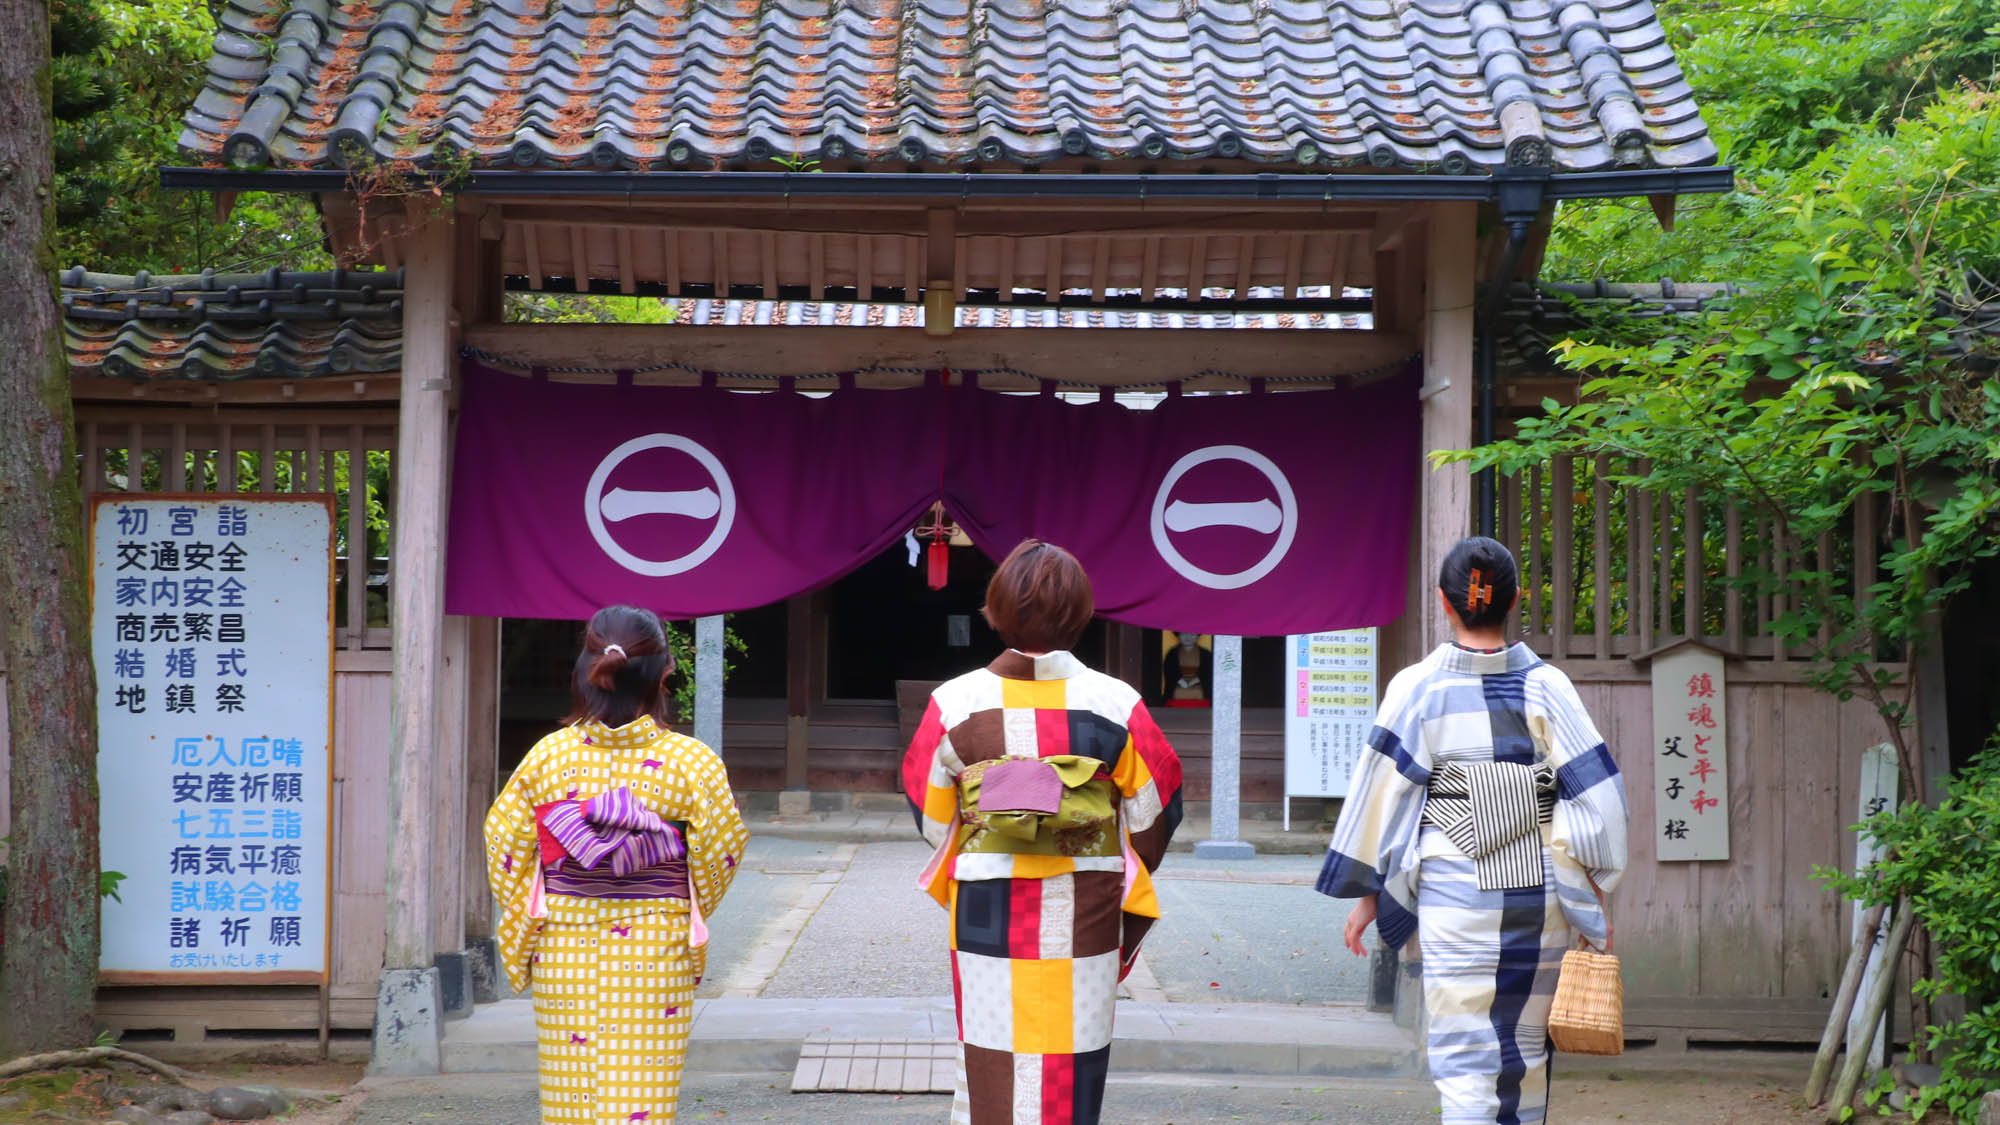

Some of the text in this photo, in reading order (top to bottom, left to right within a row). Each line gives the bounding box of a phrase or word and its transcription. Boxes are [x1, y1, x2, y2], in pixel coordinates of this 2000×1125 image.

[117, 505, 248, 536] 初宮詣
[116, 540, 248, 572] 交通安全
[115, 576, 247, 608] 家内安全
[115, 612, 246, 643] 商売繁昌
[114, 647, 247, 678] 結婚式
[115, 683, 246, 714] 地鎮祭
[172, 737, 304, 768] 厄入厄晴
[1686, 672, 1719, 816] 鎮魂と平和
[172, 772, 304, 803] 安産祈願
[1661, 736, 1690, 840] 父子桜
[171, 808, 302, 839] 七五三詣
[170, 844, 302, 876] 病気平癒
[170, 880, 303, 912] 試験合格
[170, 916, 302, 948] 諸祈願
[169, 952, 283, 968] お受けいたします
